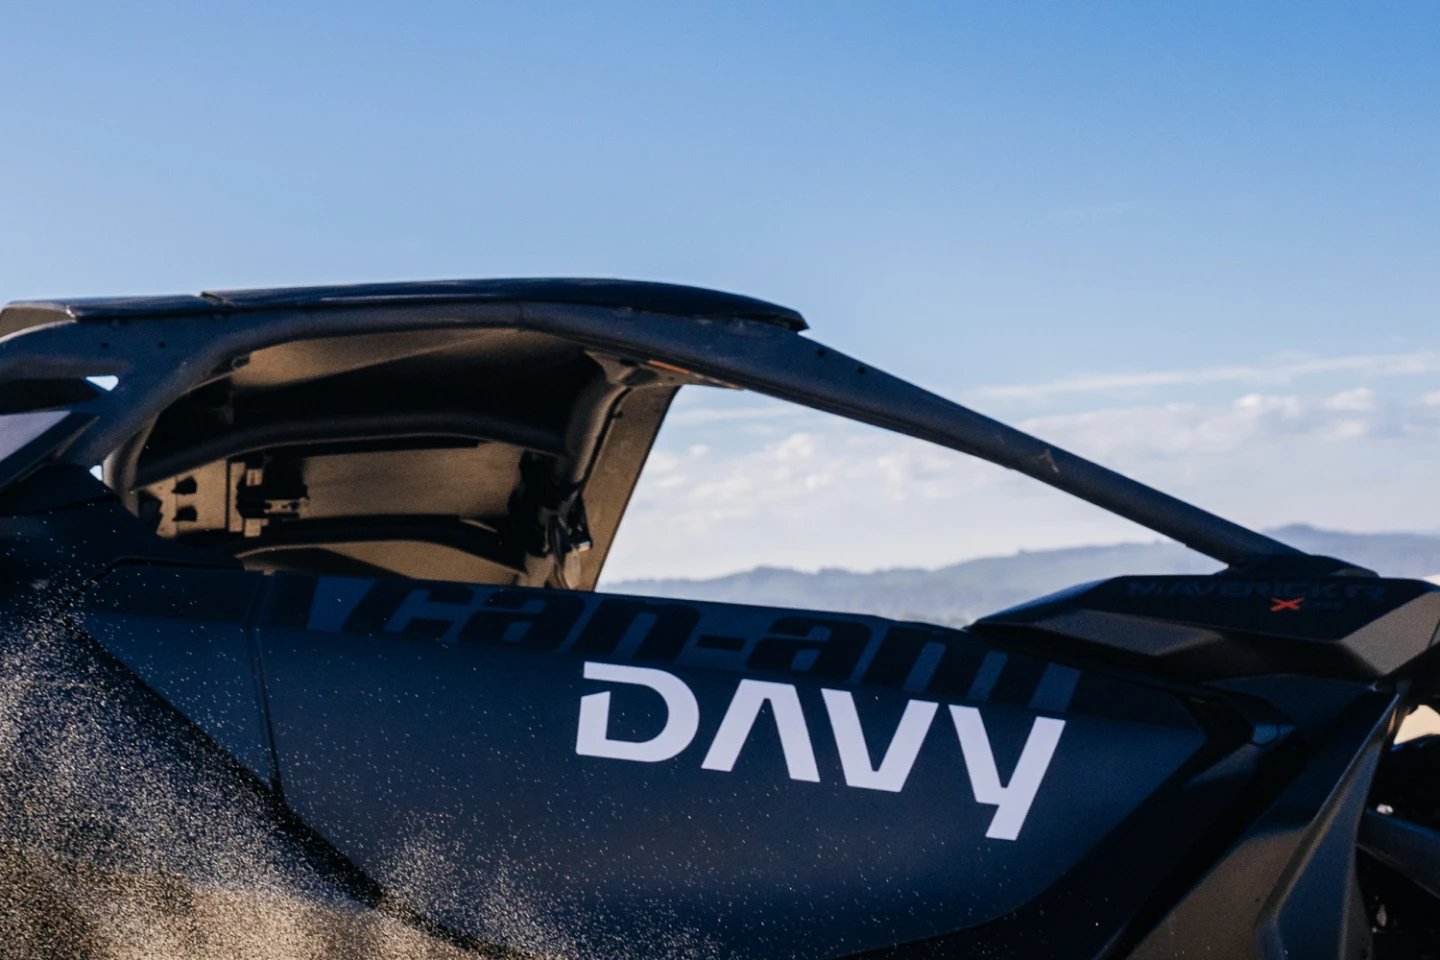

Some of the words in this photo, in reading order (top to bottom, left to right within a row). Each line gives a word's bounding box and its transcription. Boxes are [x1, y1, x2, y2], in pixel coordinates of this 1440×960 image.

[340, 578, 1052, 711] can-am
[1127, 580, 1340, 599] MAVERICK
[576, 660, 1066, 842] DAVY
